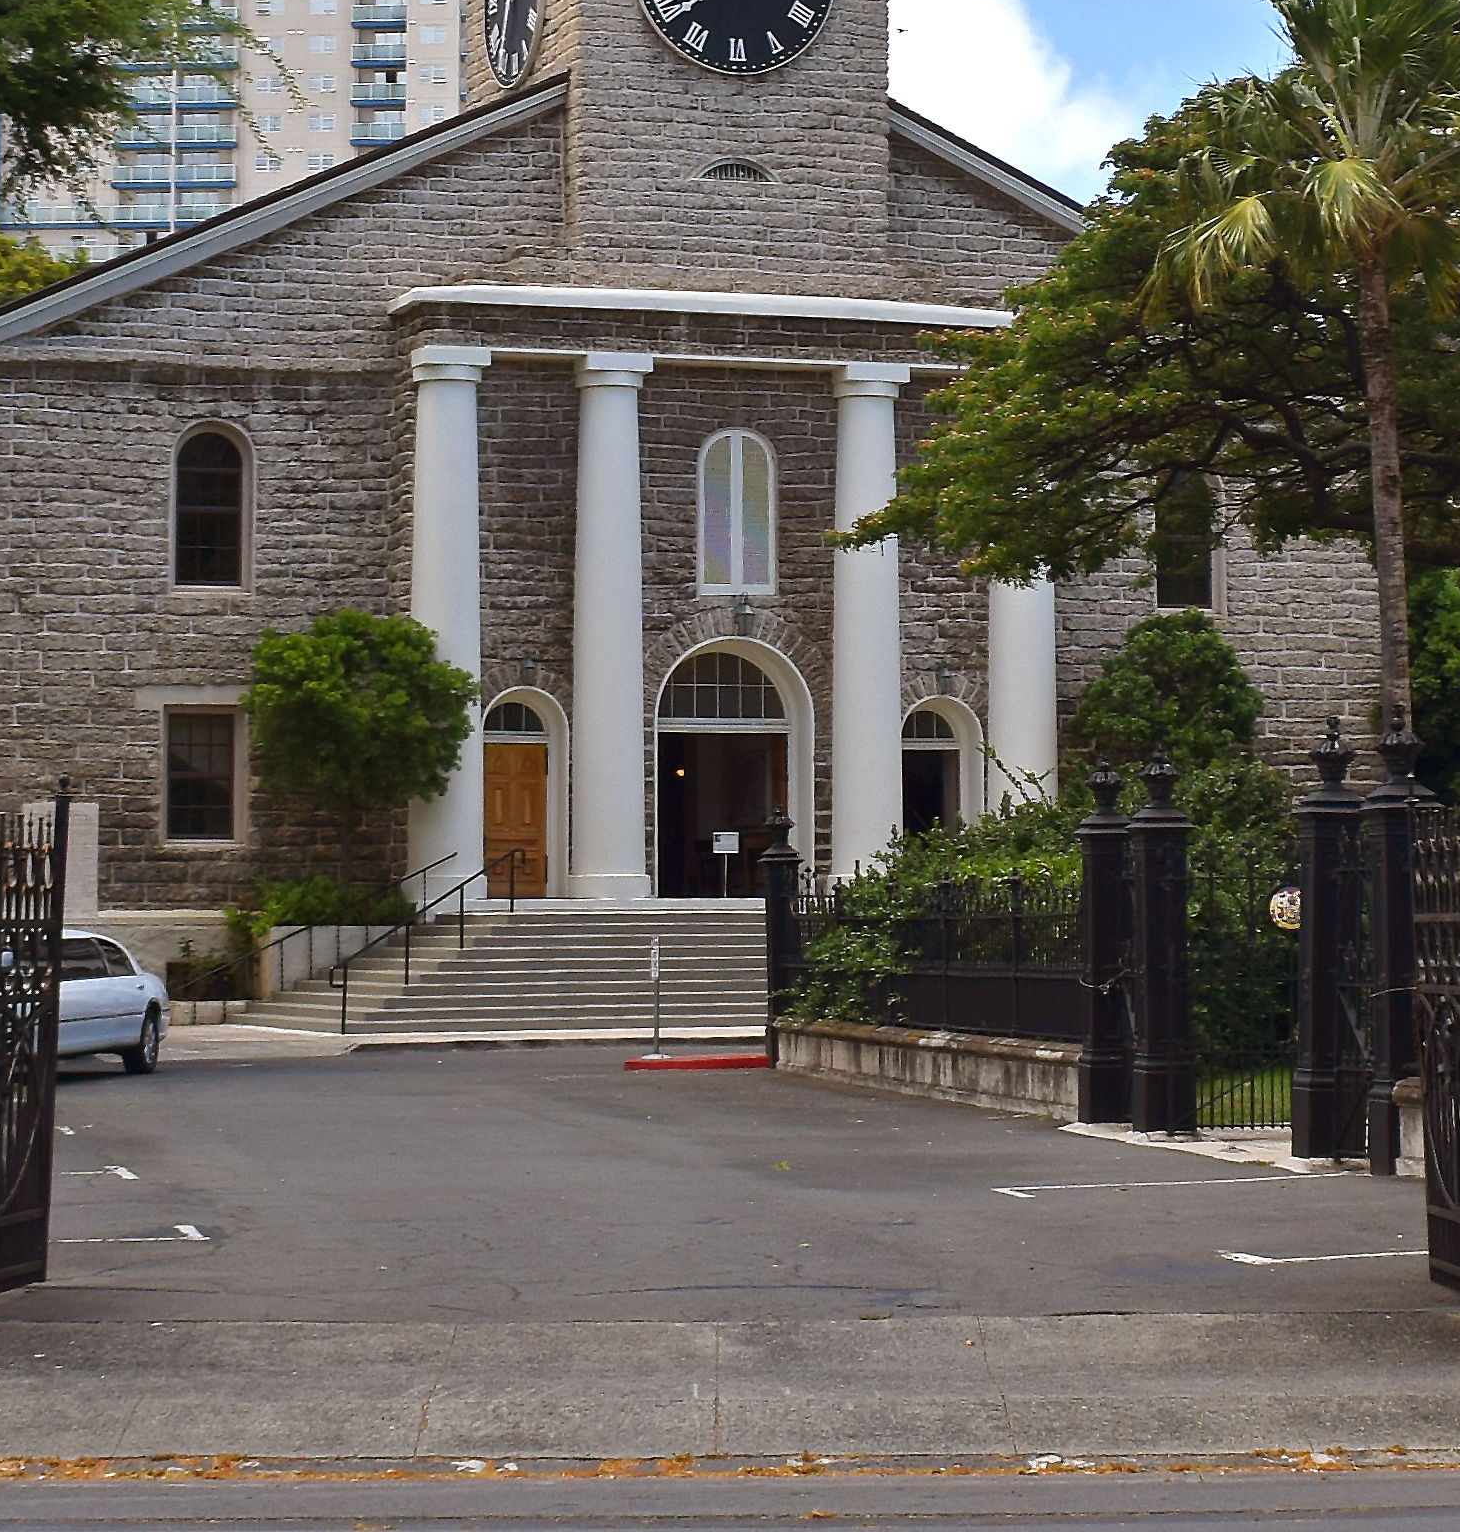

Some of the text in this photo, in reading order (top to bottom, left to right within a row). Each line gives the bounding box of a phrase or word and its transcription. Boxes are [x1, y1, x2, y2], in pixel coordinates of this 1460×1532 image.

[787, 0, 815, 28] IIII
[682, 21, 709, 53] VII
[729, 37, 747, 61] VI
[766, 30, 784, 54] V
